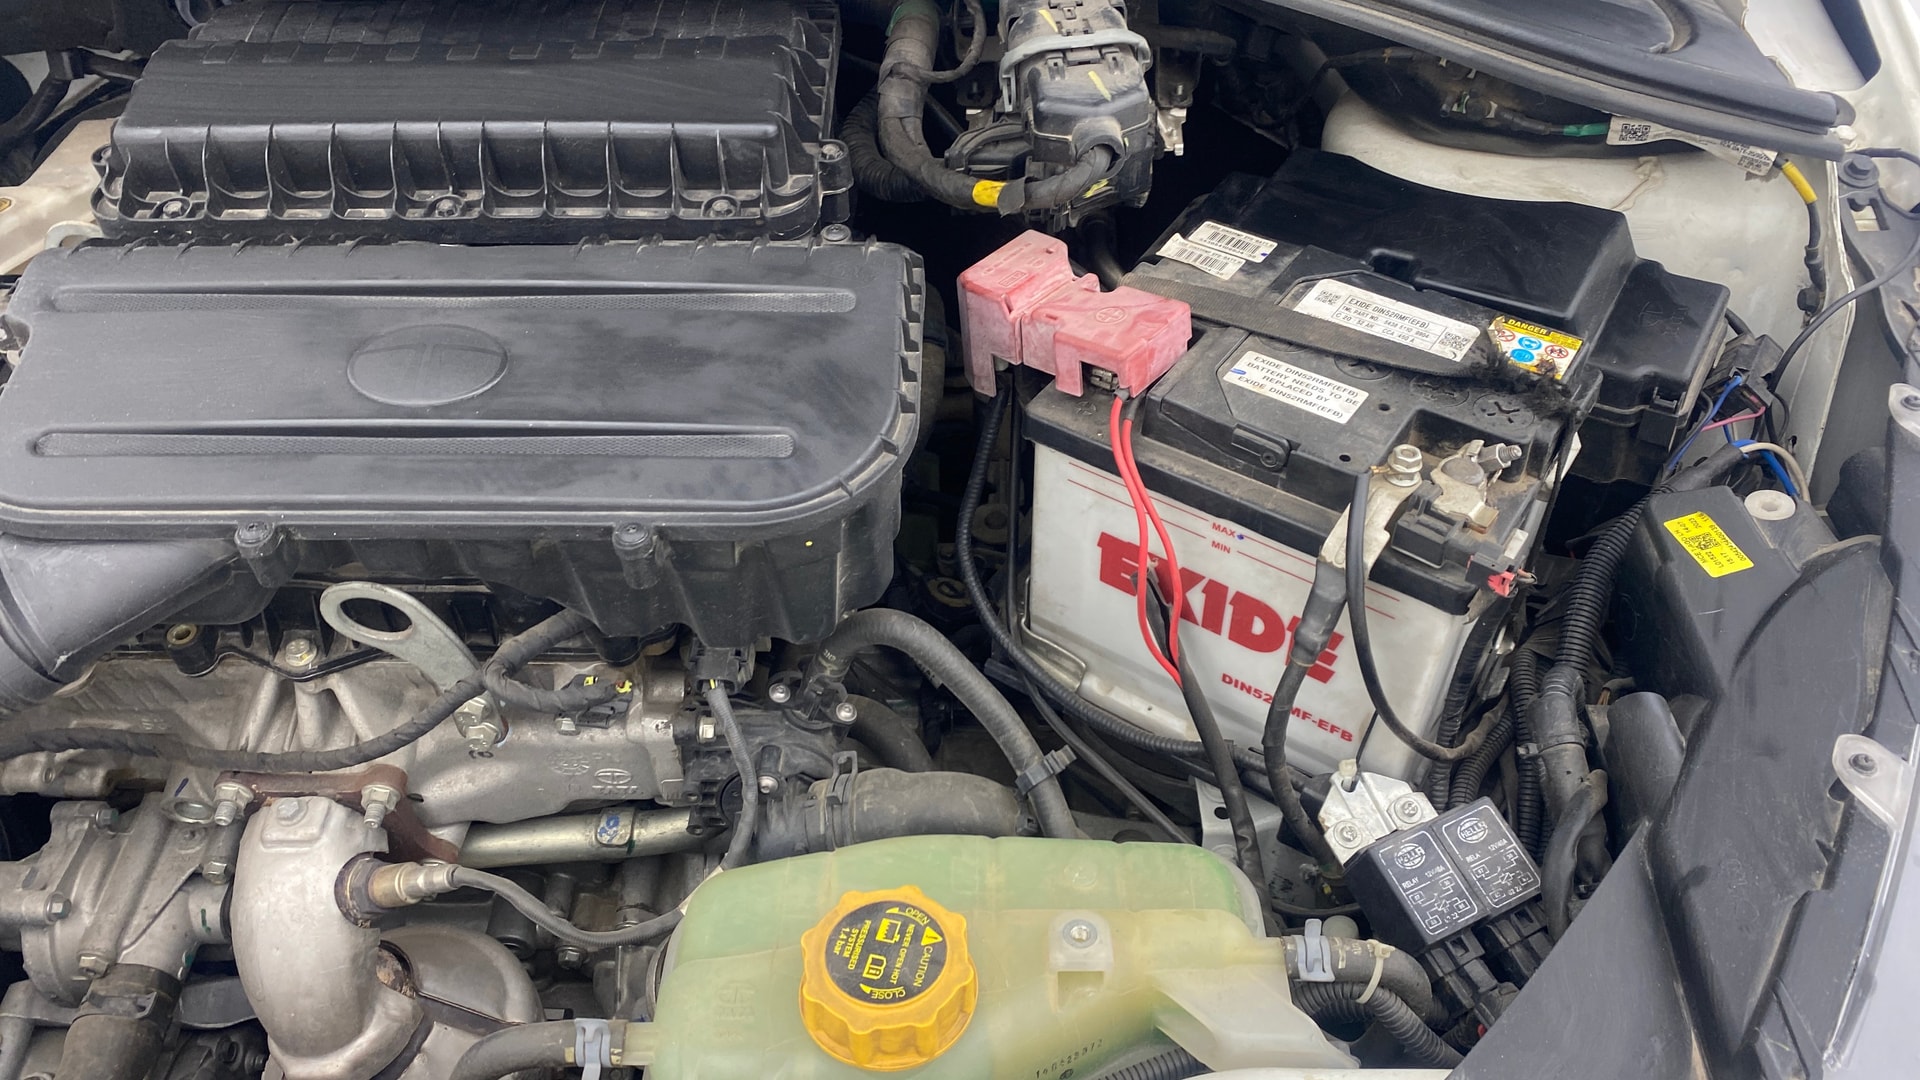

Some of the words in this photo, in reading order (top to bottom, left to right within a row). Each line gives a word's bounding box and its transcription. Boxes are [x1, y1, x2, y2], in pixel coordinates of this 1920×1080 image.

[1349, 298, 1370, 310] EXIDE
[1372, 306, 1430, 329] DIN52RMF(EFB)
[1353, 309, 1368, 318] PART
[1381, 328, 1394, 336] CCA
[1508, 319, 1548, 335] DANGER
[1246, 362, 1290, 380] BATTERY
[1292, 378, 1325, 393] NEEDS
[1329, 391, 1342, 400] TO
[1345, 398, 1360, 406] BE
[1254, 356, 1281, 370] EXIDE
[1284, 368, 1359, 398] DIN52RMF(EFB)
[1262, 375, 1313, 397] REPLACED
[1238, 376, 1266, 389] EXIDE
[1269, 387, 1343, 418] DIN52RMF(EFB)
[1211, 522, 1237, 539] MAX
[1211, 540, 1232, 554] MIN
[1221, 673, 1354, 743] DIN52MF-EFB
[1466, 851, 1481, 863] RELA
[1402, 877, 1419, 889] RELAY
[906, 907, 930, 926] OPEN
[839, 928, 850, 939] 1.4
[843, 928, 859, 958] SYSTEM
[902, 923, 915, 948] NEVER
[834, 940, 845, 955] bar
[848, 920, 871, 970] PRESSURISED
[895, 948, 907, 969] OPEN
[913, 946, 933, 987] CAUTION
[890, 969, 900, 984] HOT
[871, 988, 906, 999] CLOSE
